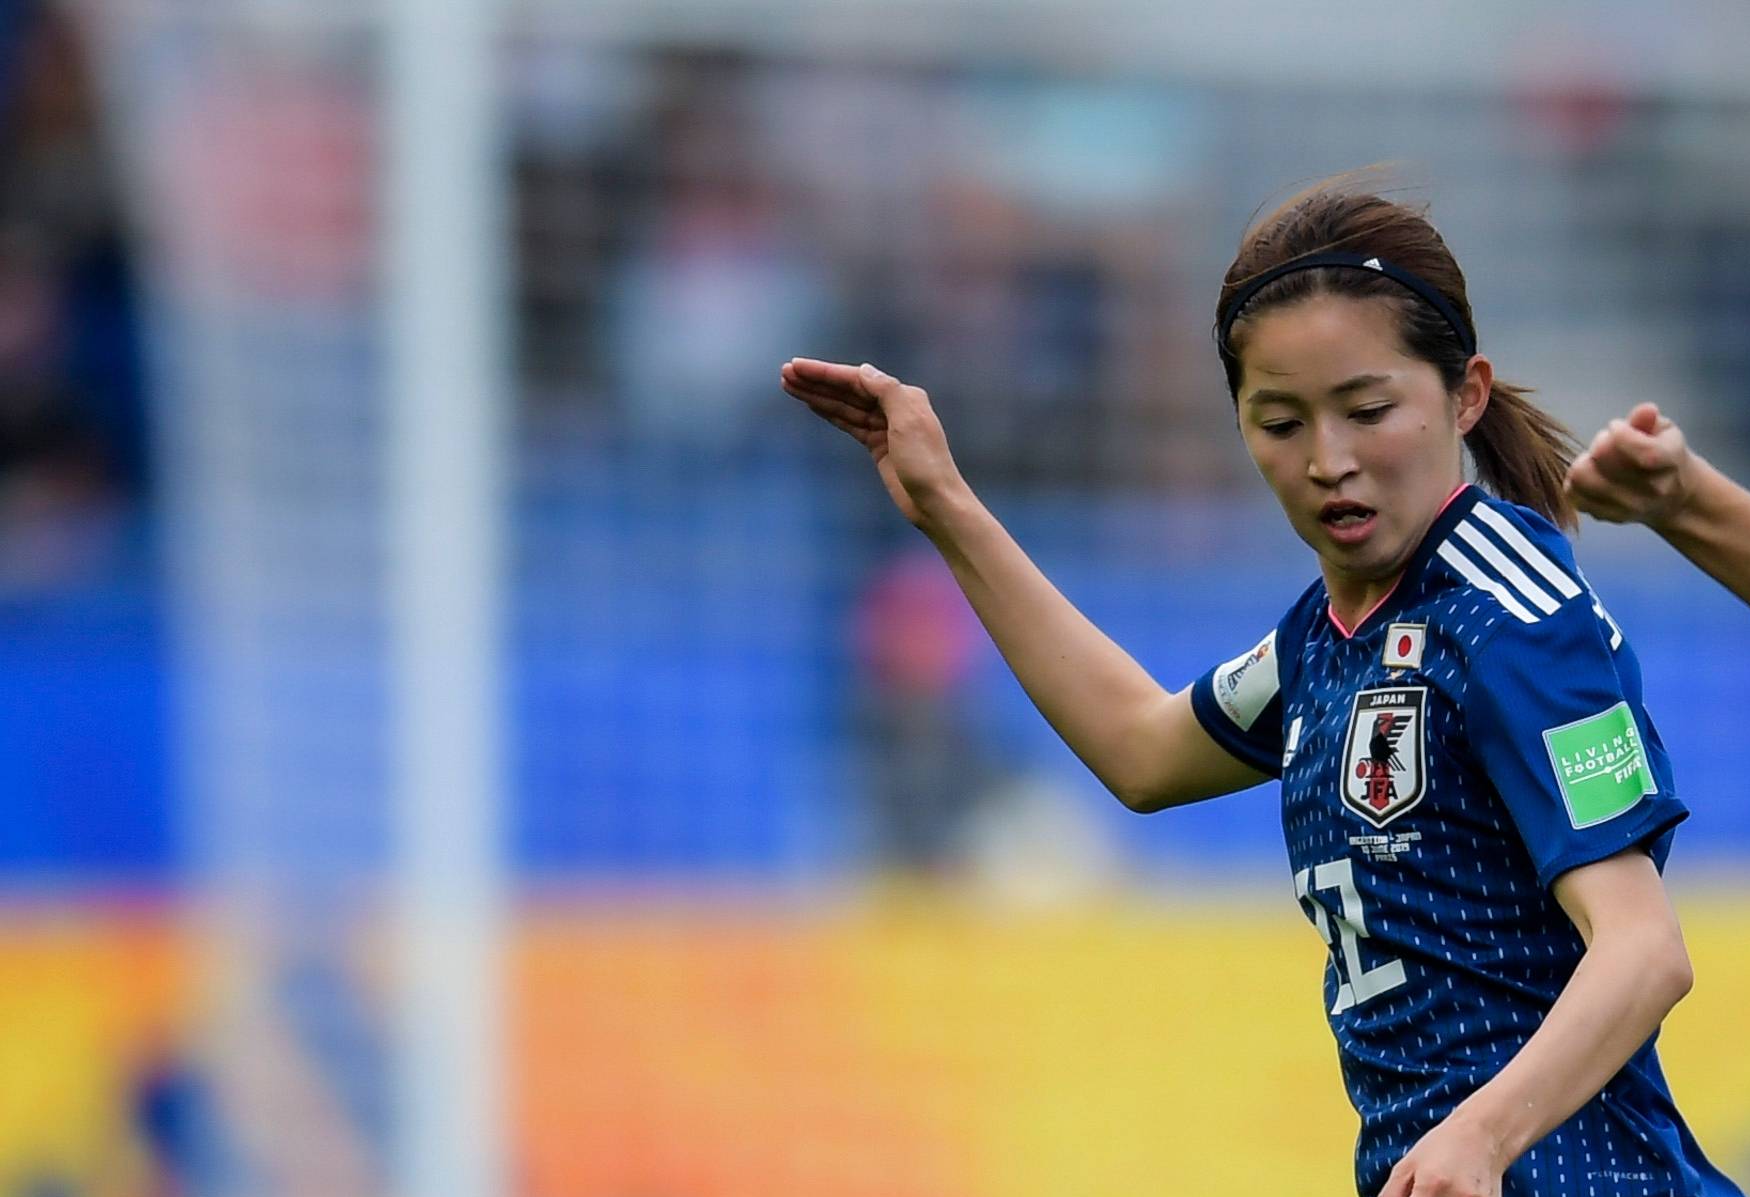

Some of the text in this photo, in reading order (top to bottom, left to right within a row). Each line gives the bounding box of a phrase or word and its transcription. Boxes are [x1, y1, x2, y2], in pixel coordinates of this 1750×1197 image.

[1369, 693, 1406, 706] JAPAN
[1561, 727, 1635, 767] LIVING
[1564, 738, 1638, 778] FOOTBALL
[1614, 755, 1643, 784] FIFA
[1360, 780, 1399, 801] JFA
